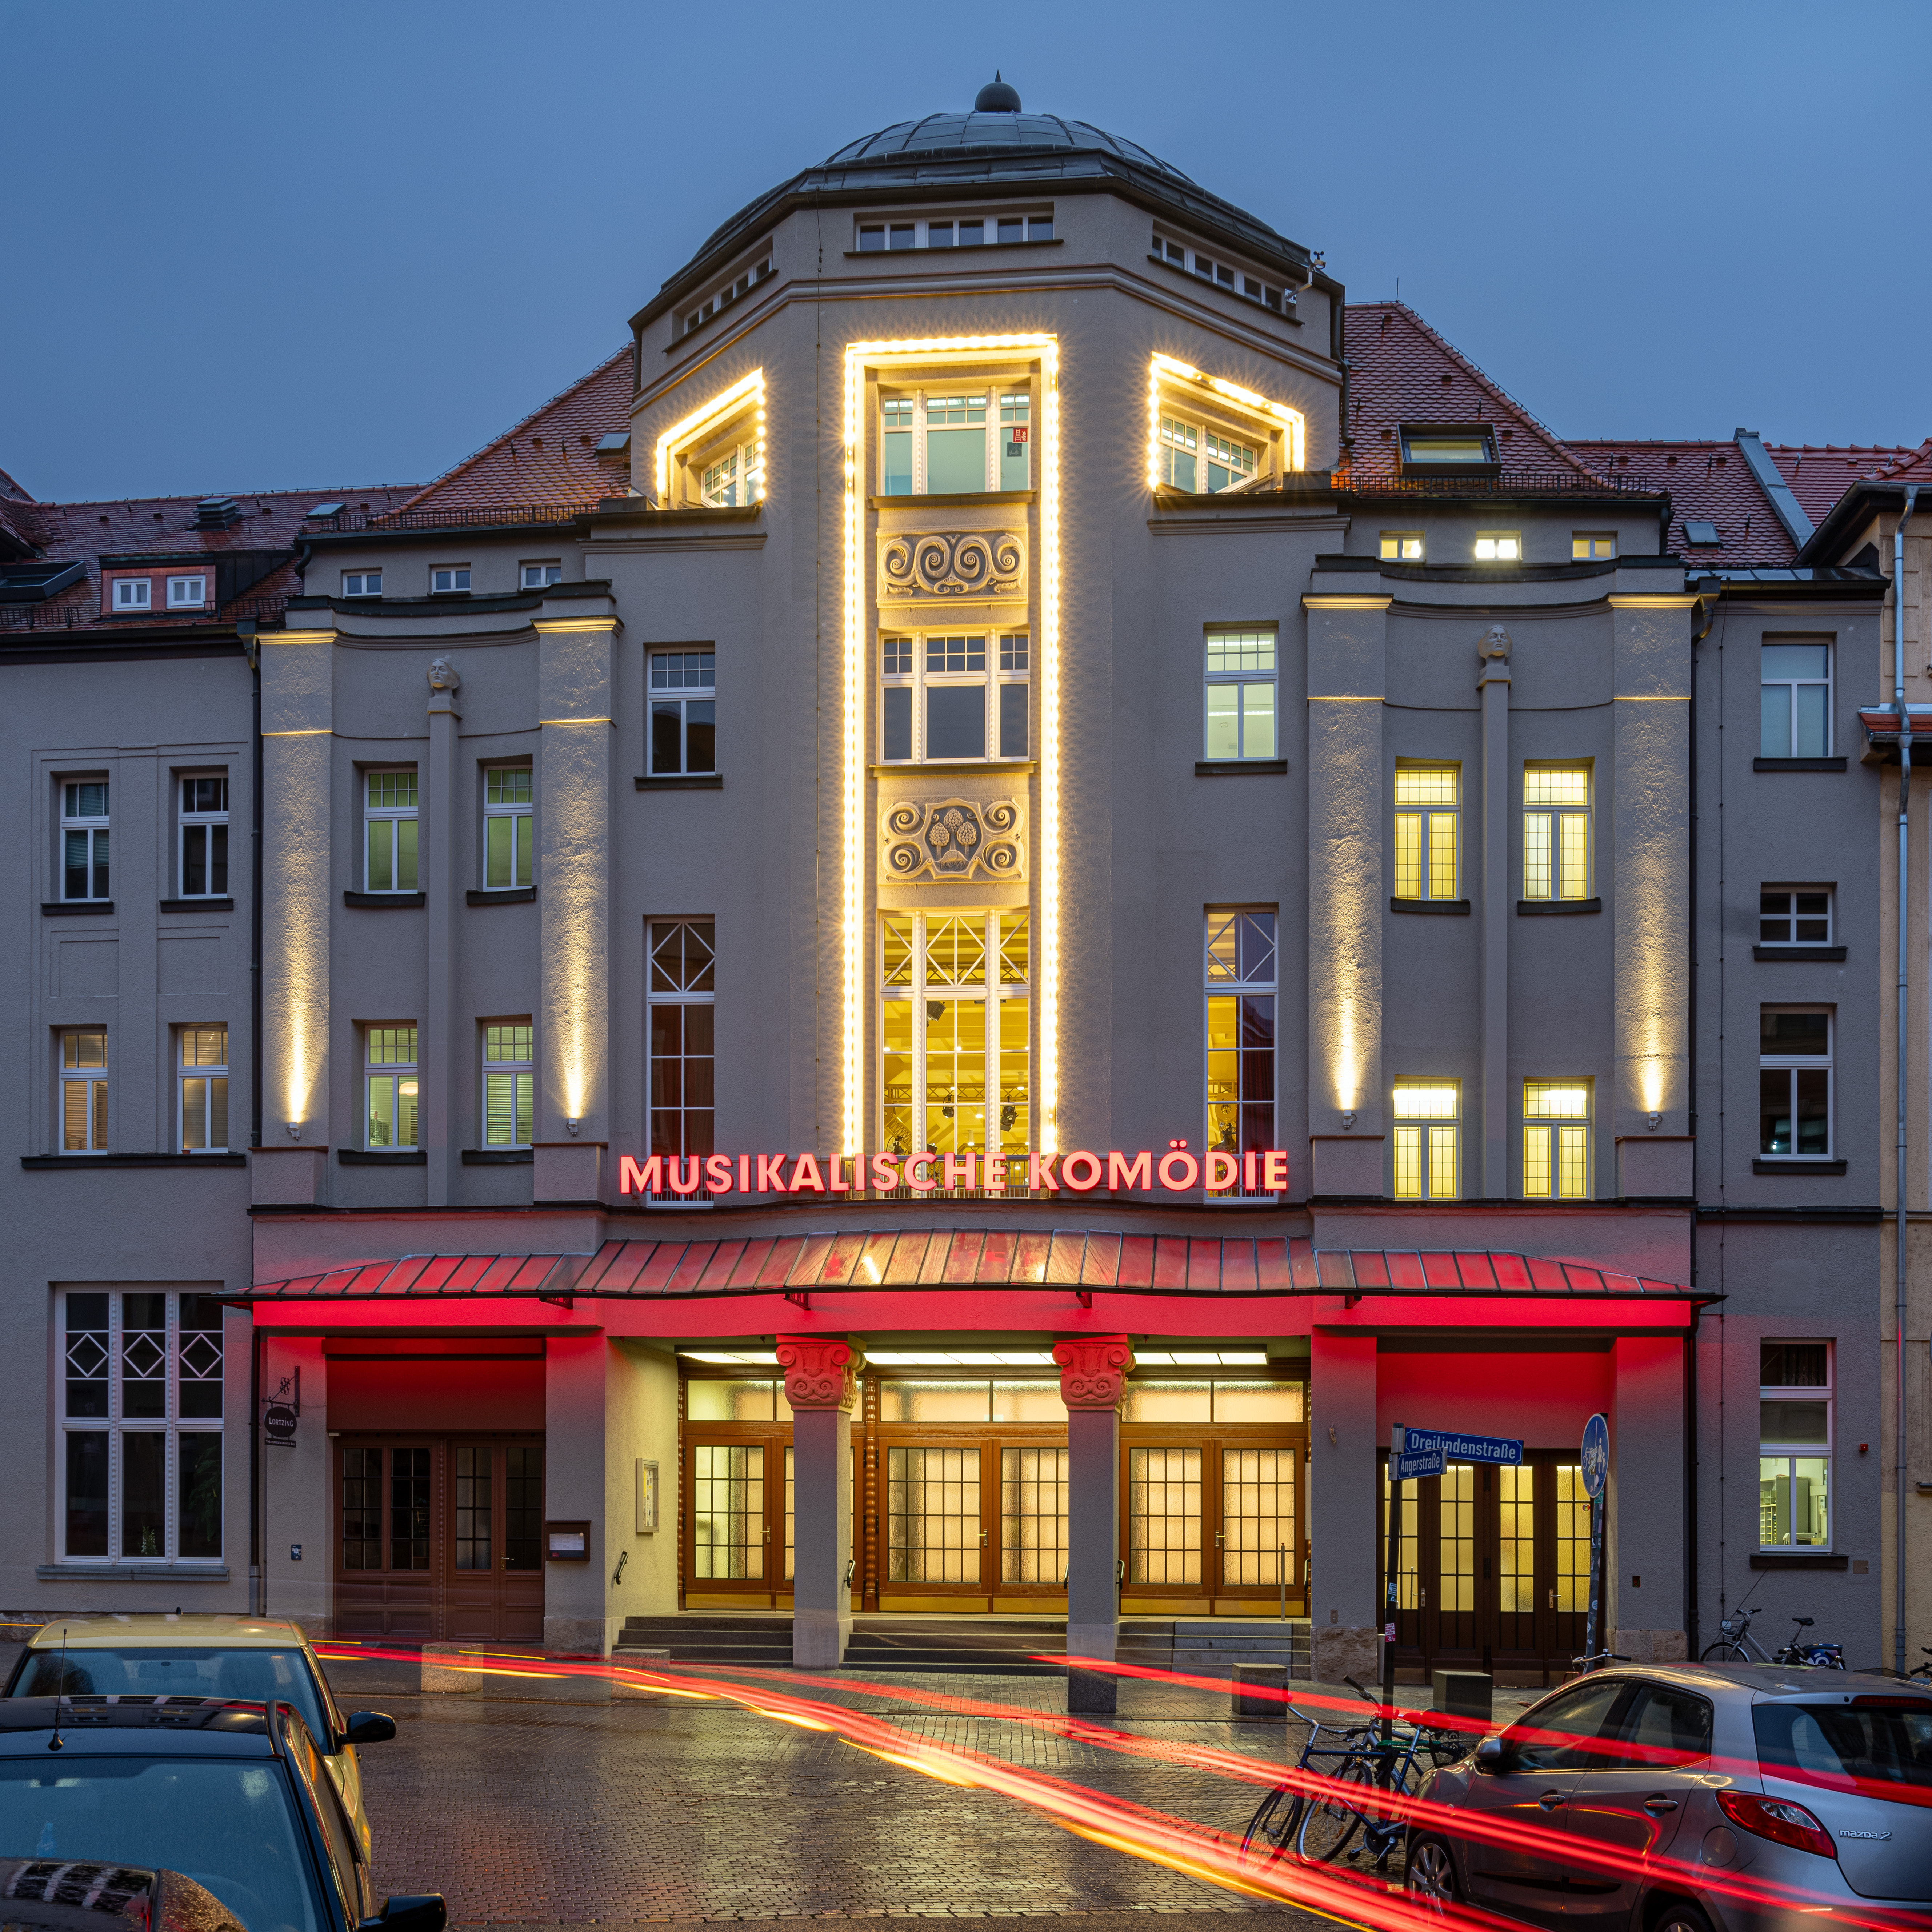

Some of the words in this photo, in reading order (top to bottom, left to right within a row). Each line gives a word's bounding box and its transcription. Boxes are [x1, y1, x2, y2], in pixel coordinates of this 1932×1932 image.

[620, 1151, 1007, 1194] MUSIKALISCHE
[1029, 1140, 1288, 1191] KOMÖDIE
[1411, 1433, 1516, 1459] Dreilindenstraße
[1400, 1453, 1440, 1476] Angerstraße
